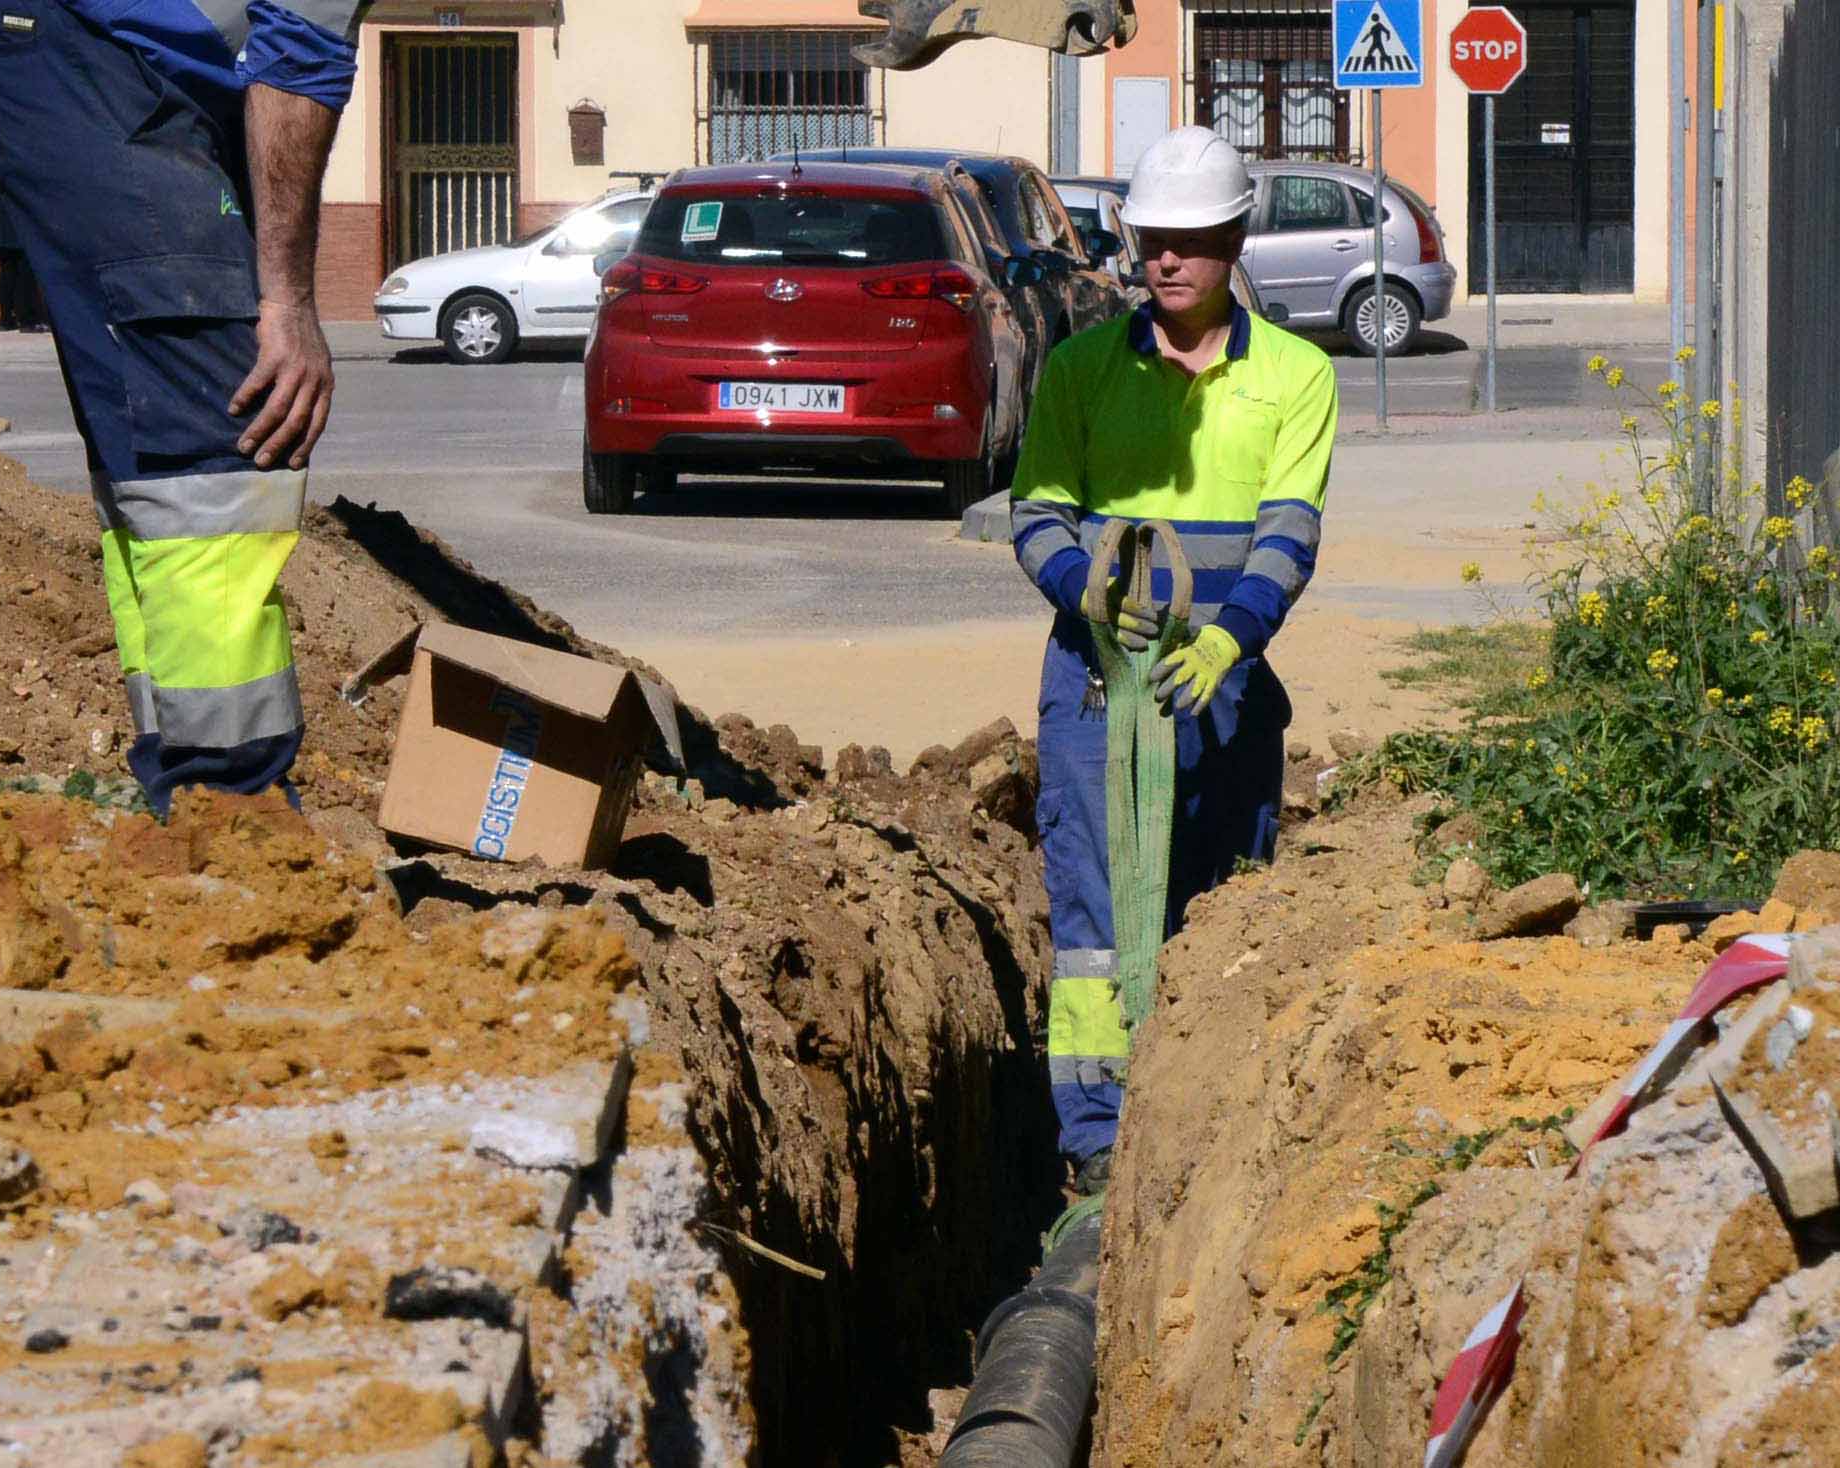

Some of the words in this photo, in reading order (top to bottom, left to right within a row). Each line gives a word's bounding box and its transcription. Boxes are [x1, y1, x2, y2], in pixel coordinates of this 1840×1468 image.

[1455, 40, 1518, 60] STOP
[688, 207, 715, 233] L
[734, 386, 787, 406] 0941
[798, 387, 840, 409] JXW
